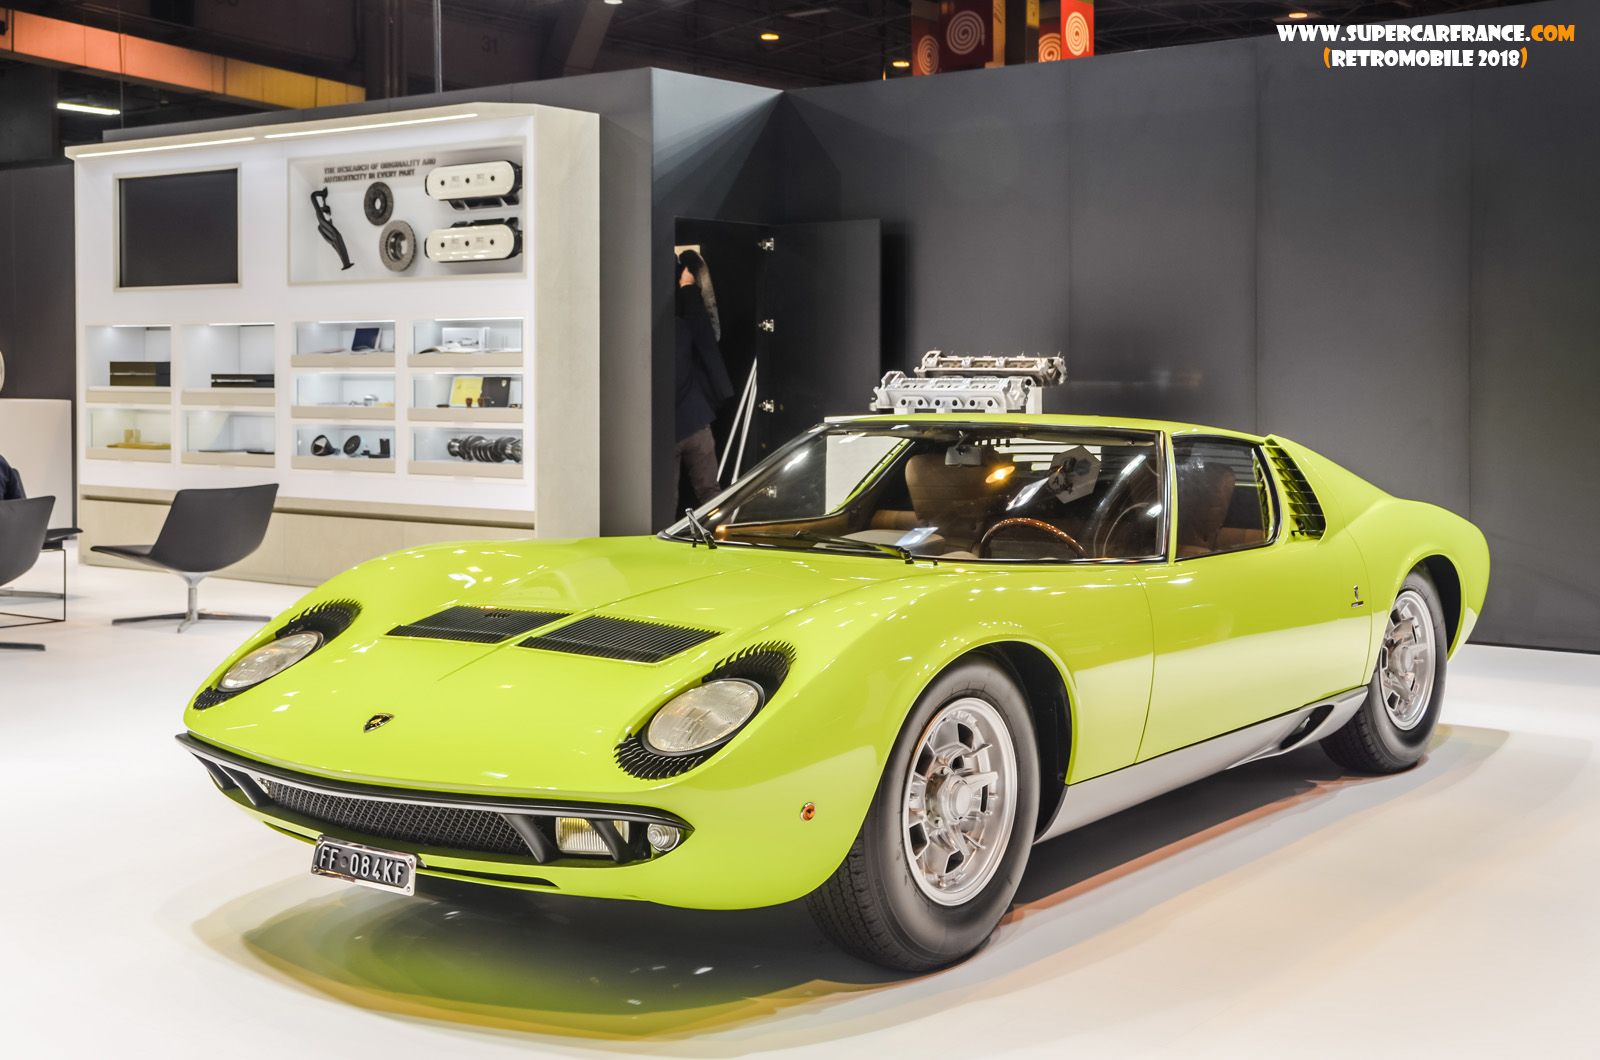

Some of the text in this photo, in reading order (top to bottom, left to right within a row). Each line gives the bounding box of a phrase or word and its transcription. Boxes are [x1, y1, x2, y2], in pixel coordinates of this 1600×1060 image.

[337, 164, 369, 173] RESEARCH
[380, 159, 421, 168] ORIGINALITY
[323, 173, 367, 183] AUTHENTICITY
[377, 170, 397, 178] EVERY
[320, 846, 405, 884] FF 084KF
